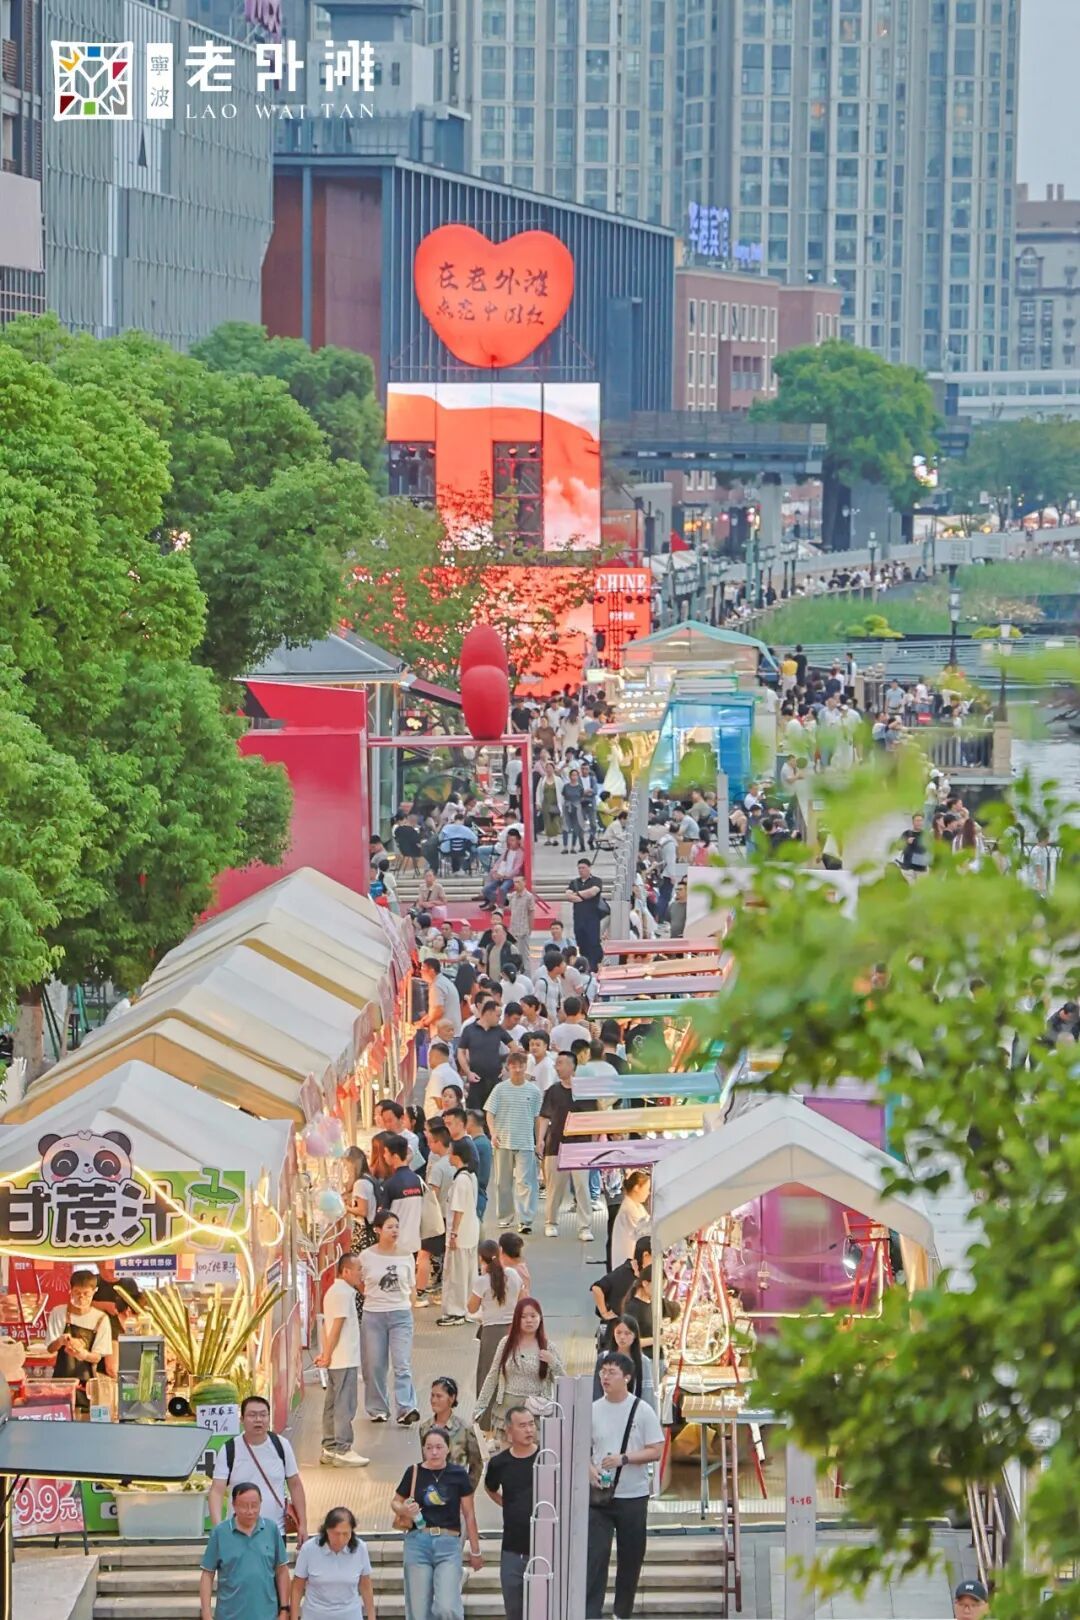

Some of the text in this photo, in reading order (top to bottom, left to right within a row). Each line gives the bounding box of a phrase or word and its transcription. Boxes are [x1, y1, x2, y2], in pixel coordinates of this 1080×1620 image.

[0, 1183, 181, 1244] 甘蔗汁
[15, 1484, 80, 1525] 9.9元
[790, 1495, 813, 1506] 1-16
